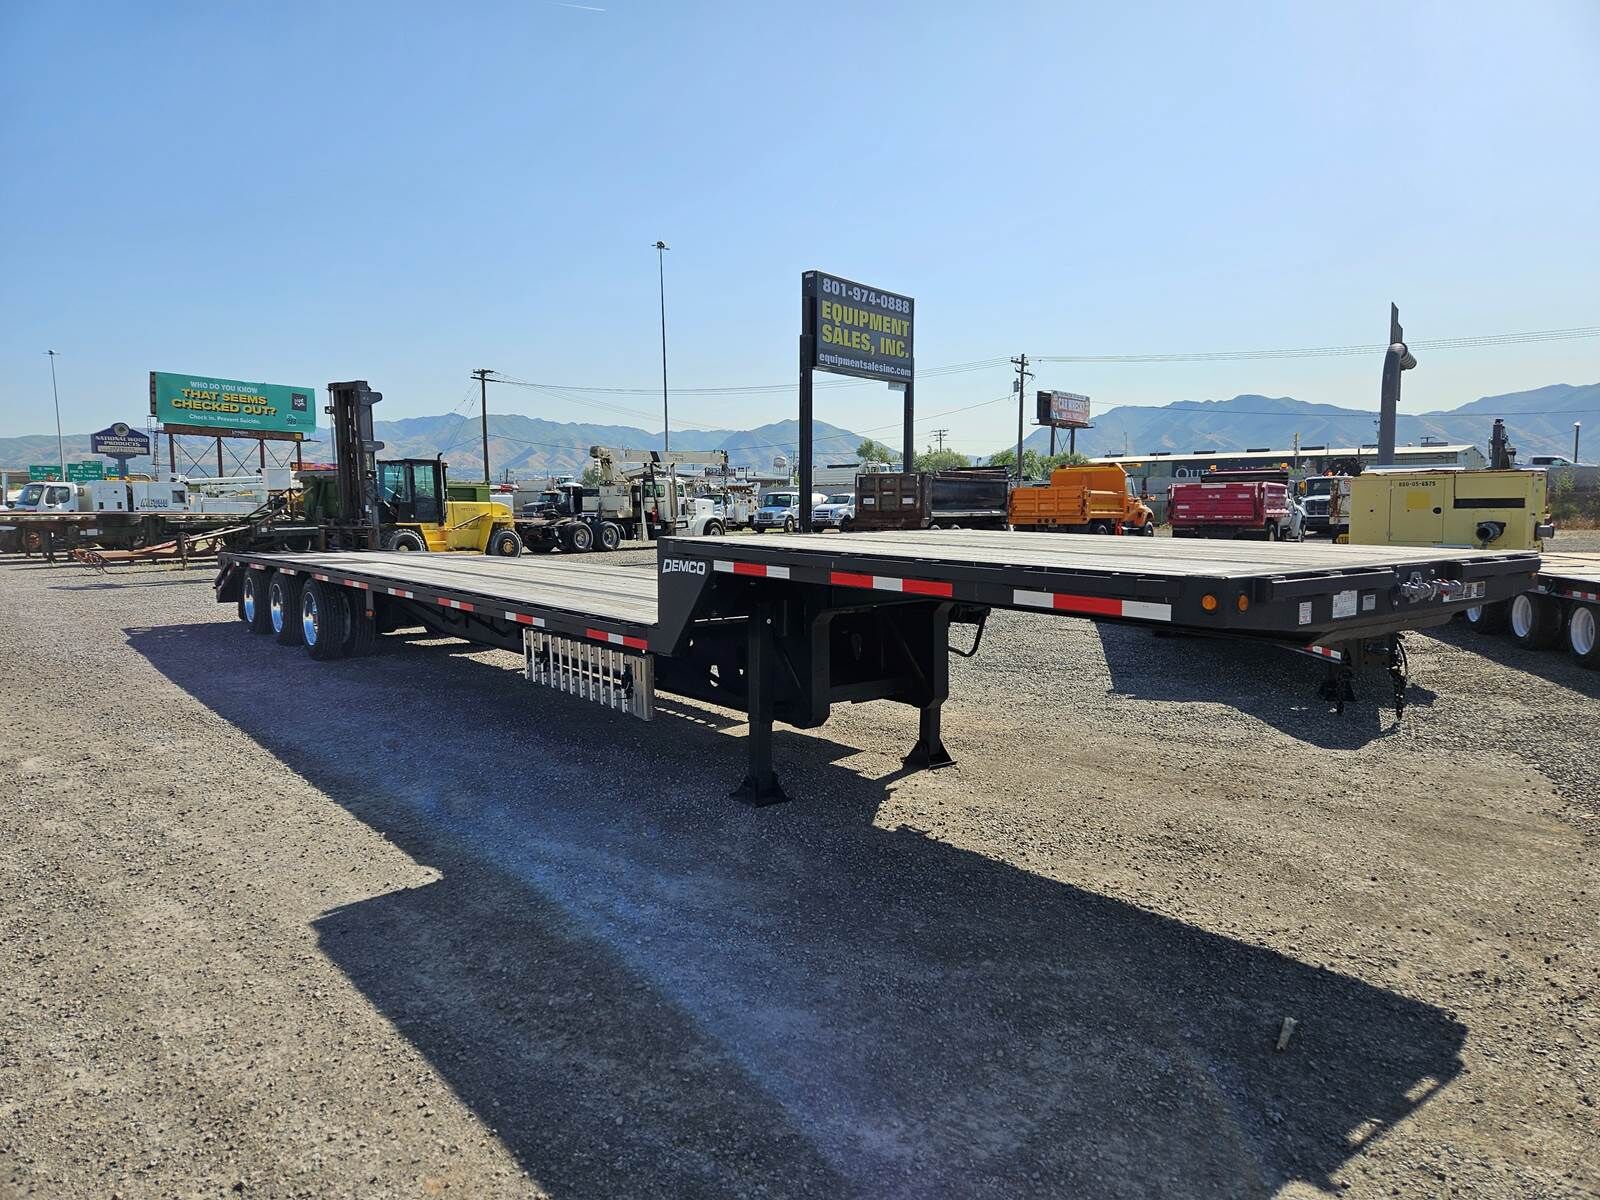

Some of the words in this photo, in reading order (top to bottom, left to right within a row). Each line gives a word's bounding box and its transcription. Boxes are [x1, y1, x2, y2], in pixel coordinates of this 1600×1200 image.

[822, 278, 910, 314] 801-974-0888
[822, 299, 910, 337] EQUIPMENT
[822, 323, 875, 356] SALES,
[880, 337, 909, 358] INC.
[819, 353, 911, 377] equipmentsalesinc.com
[182, 388, 219, 400] THAT
[222, 392, 267, 405] SEEMS
[190, 381, 208, 389] WHO
[221, 384, 236, 392] YOU
[237, 385, 258, 393] KNOW
[171, 398, 240, 414] CHECKED
[243, 403, 278, 417] OUT?
[662, 559, 706, 575] DEMCO
